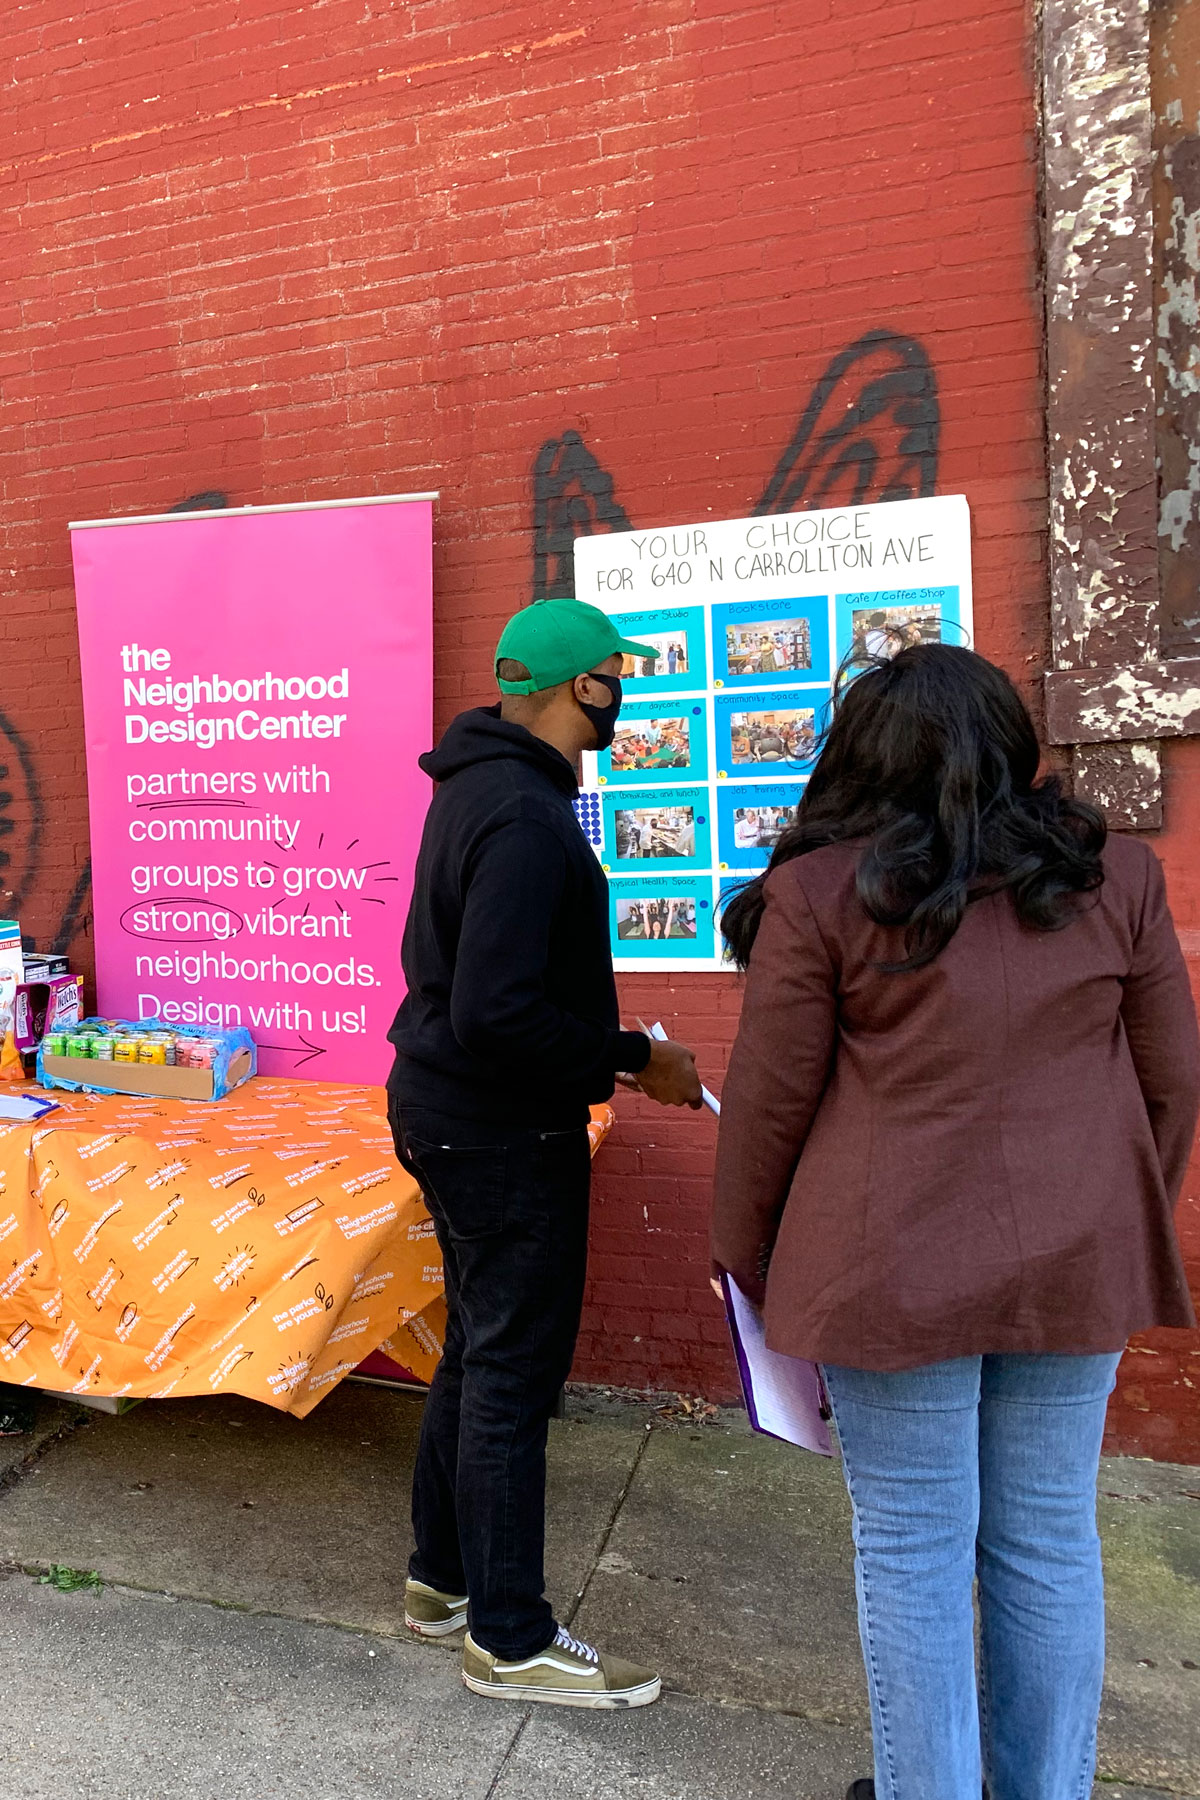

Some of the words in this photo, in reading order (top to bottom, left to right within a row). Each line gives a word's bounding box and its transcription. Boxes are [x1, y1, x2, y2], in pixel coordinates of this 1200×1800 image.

[631, 530, 708, 560] YOUR
[746, 512, 872, 549] CHOICE
[597, 568, 634, 592] FOR
[651, 561, 693, 587] 640
[710, 557, 723, 582] N
[734, 543, 873, 580] CARROLLTON
[882, 534, 935, 566] AVE
[728, 600, 792, 614] Bookstore
[845, 592, 870, 604] Cafe
[881, 590, 917, 601] Coffee
[919, 588, 946, 600] Shop
[616, 613, 644, 625] Space
[661, 610, 689, 620] Studio
[120, 643, 171, 672] the
[123, 668, 349, 713] Neighborhood
[717, 694, 766, 706] Community
[771, 691, 800, 701] Space
[649, 701, 681, 711] daycare
[125, 710, 347, 749] DesignCenter
[127, 768, 257, 803] partners
[263, 764, 330, 793] with
[730, 786, 748, 795] Job
[750, 784, 786, 795] Training
[128, 813, 301, 849] community
[131, 863, 239, 894] groups
[245, 861, 275, 888] to
[283, 866, 367, 896] grow
[610, 879, 638, 889] hysical
[642, 878, 667, 886] Health
[672, 877, 697, 886] Space
[133, 906, 237, 940] strong,
[244, 907, 352, 938] vibrant
[136, 950, 382, 987] neighborhoods.
[137, 993, 242, 1026] Design
[248, 1002, 312, 1031] with
[322, 1005, 367, 1034] us!
[145, 1174, 159, 1185] the
[158, 1161, 183, 1175] lights
[208, 1174, 223, 1184] the
[224, 1163, 251, 1177] power
[284, 1171, 300, 1181] the
[300, 1154, 349, 1174] playground
[341, 1179, 357, 1189] the
[357, 1166, 392, 1181] schools
[86, 1178, 100, 1187] the
[90, 1183, 103, 1192] are
[149, 1179, 163, 1190] are
[288, 1179, 298, 1187] is
[346, 1184, 361, 1194] are
[132, 1232, 145, 1245] the
[144, 1197, 185, 1233] community
[211, 1215, 225, 1227] the
[225, 1199, 249, 1217] parks
[274, 1218, 290, 1230] the
[289, 1201, 319, 1220] corner
[278, 1229, 288, 1237] is
[287, 1213, 315, 1232] yours.
[335, 1215, 349, 1225] the
[339, 1201, 396, 1231] Neighborhood
[216, 1221, 230, 1234] are
[344, 1211, 399, 1240] DesignCenter
[407, 1233, 415, 1241] is
[416, 1230, 437, 1241] your
[408, 1224, 423, 1233] the
[136, 1243, 145, 1252] is
[151, 1273, 165, 1286] the
[163, 1248, 188, 1274] streets
[212, 1271, 227, 1285] the
[225, 1252, 247, 1273] lights
[90, 1286, 100, 1299] the
[99, 1266, 114, 1287] block
[157, 1280, 170, 1294] are
[219, 1278, 233, 1292] are
[96, 1298, 102, 1306] is
[272, 1310, 289, 1324] the
[289, 1297, 315, 1316] parks
[277, 1319, 293, 1332] are
[293, 1306, 323, 1325] yours.
[144, 1351, 156, 1365] the
[154, 1302, 196, 1353] neighborhood
[149, 1363, 157, 1372] is
[266, 1371, 284, 1385] the
[283, 1360, 309, 1377] lights
[272, 1381, 289, 1395] are
